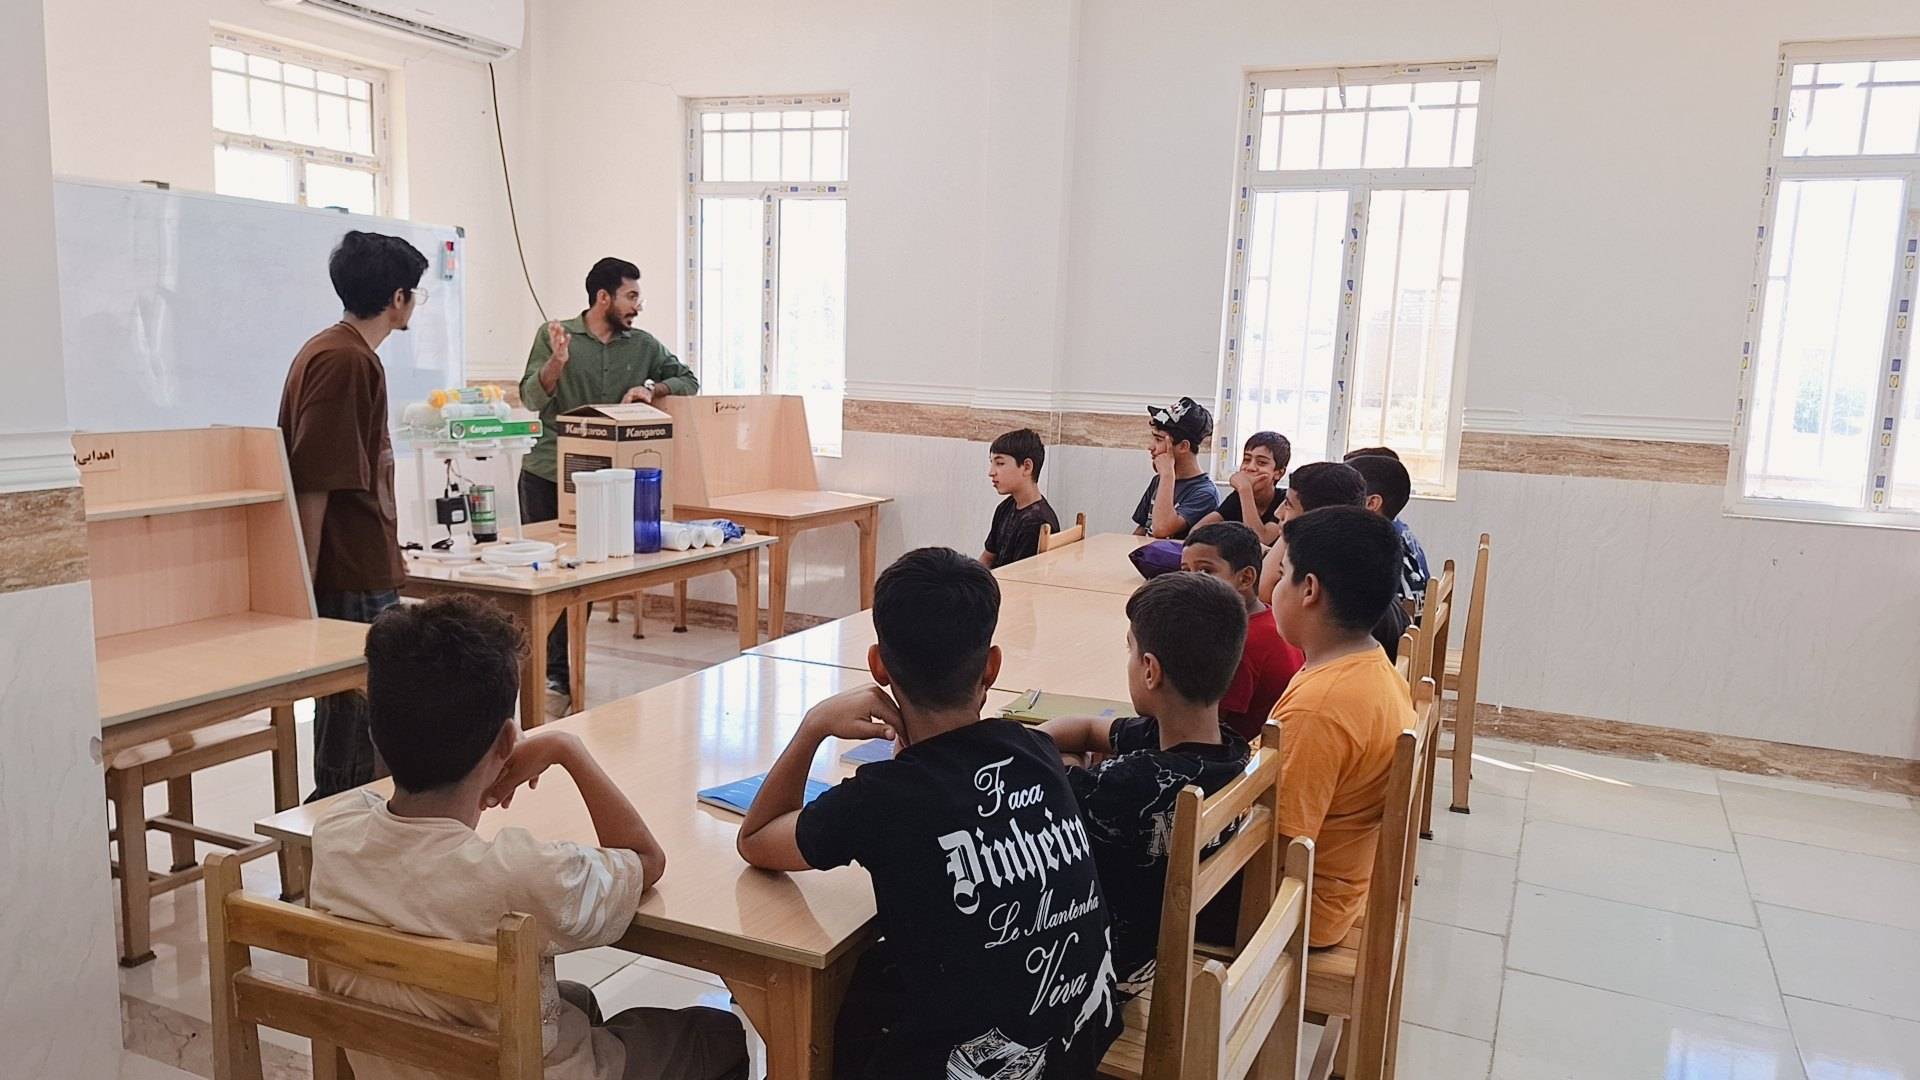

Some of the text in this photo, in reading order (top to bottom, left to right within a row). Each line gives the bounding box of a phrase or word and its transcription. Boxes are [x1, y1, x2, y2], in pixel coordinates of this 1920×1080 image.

[565, 423, 608, 437] Kangaroo
[626, 427, 667, 438] Kangaroo
[937, 807, 1090, 915] Dinheiro
[1024, 880, 1099, 937] Mantenha
[1026, 932, 1087, 1016] Viva
